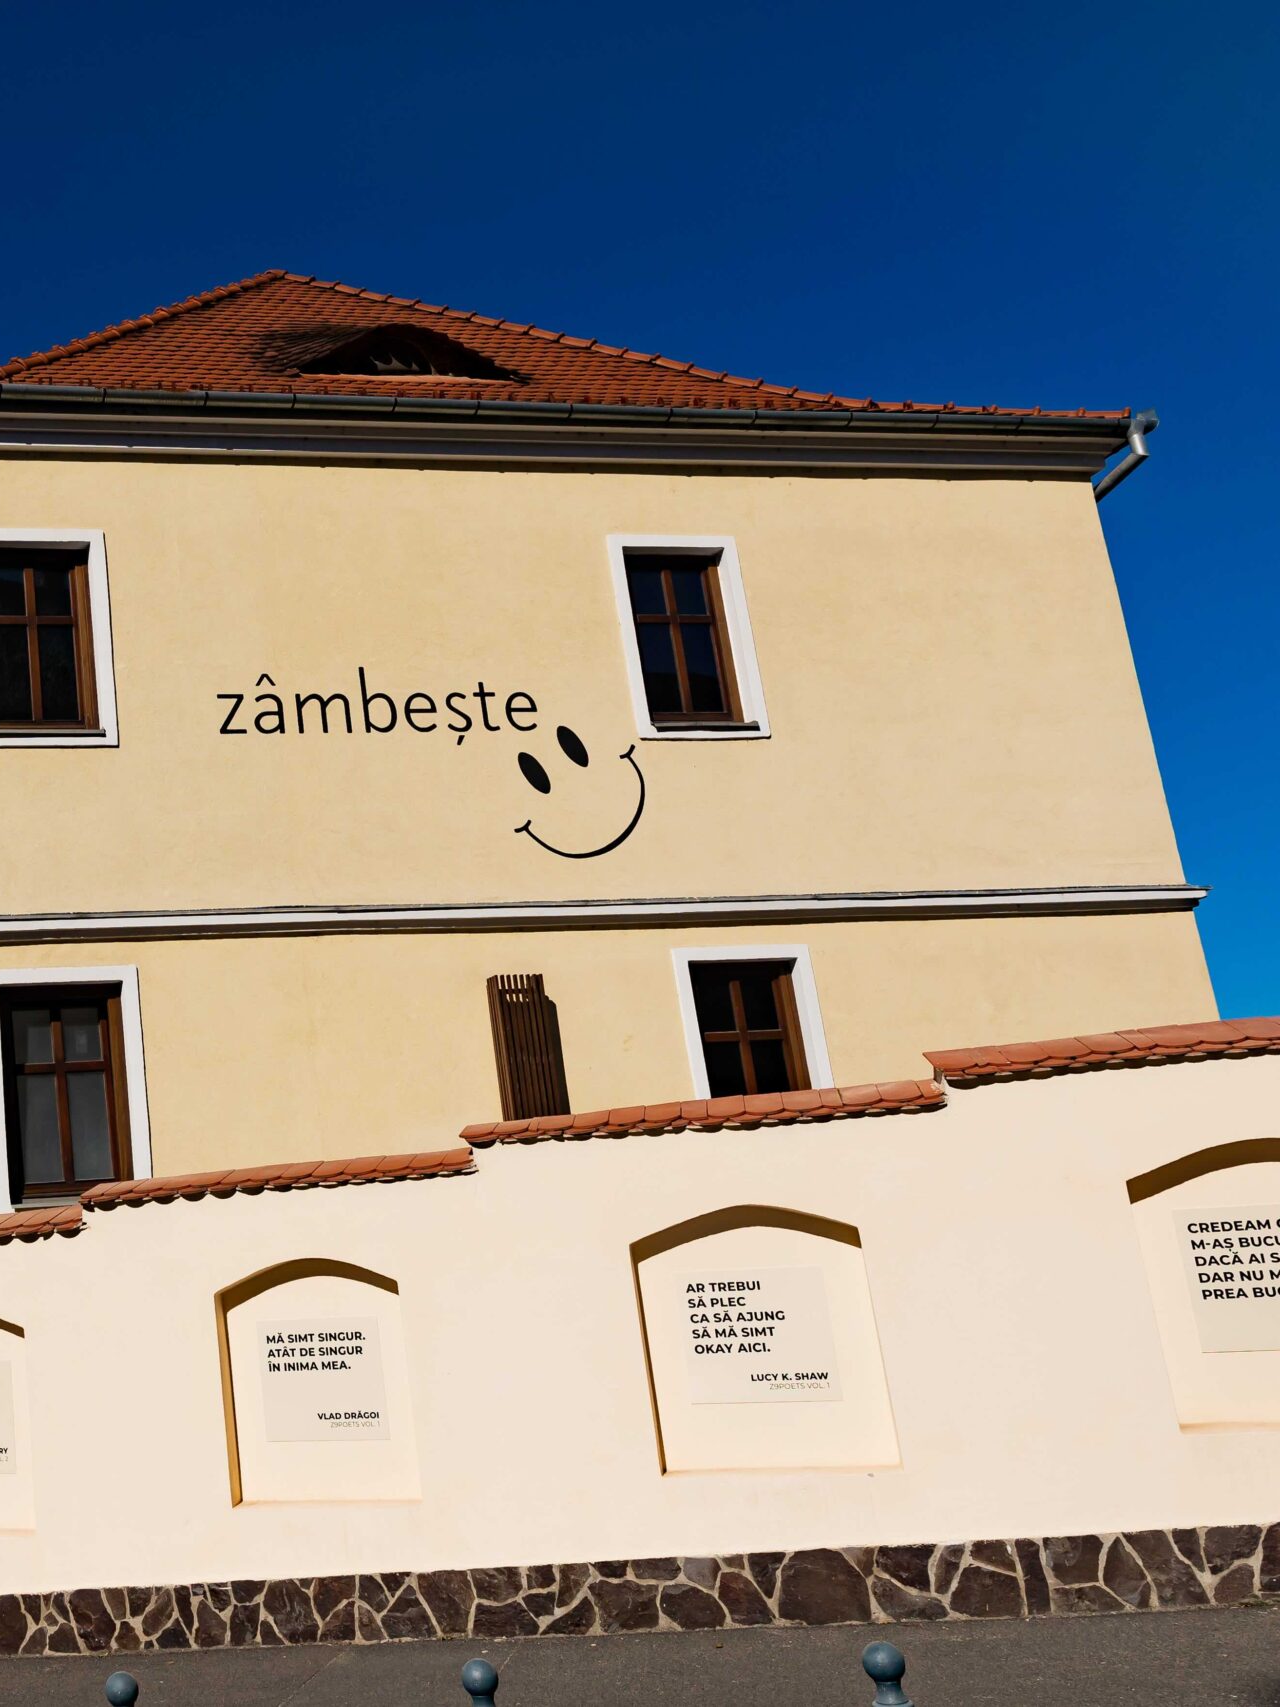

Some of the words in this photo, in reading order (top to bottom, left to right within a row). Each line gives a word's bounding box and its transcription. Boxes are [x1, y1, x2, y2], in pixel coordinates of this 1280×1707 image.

[217, 666, 538, 746] zâmbește
[1187, 1219, 1271, 1233] CREDEAM
[1191, 1238, 1234, 1252] M-AȘ
[1194, 1251, 1244, 1266] DACĂ
[1248, 1253, 1266, 1264] AI
[1198, 1271, 1235, 1283] DAR
[1239, 1269, 1264, 1282] NU
[686, 1283, 706, 1293] AR
[709, 1281, 761, 1292] TREBUI
[1202, 1288, 1249, 1300] PREA
[687, 1296, 707, 1309] SĂ
[710, 1297, 746, 1308] PLEC
[690, 1313, 710, 1324] CA
[713, 1310, 733, 1323] SĂ
[736, 1310, 786, 1322] AJUNG
[266, 1332, 285, 1344] MĂ
[287, 1333, 315, 1344] SIMT
[318, 1331, 366, 1342] SINGUR.
[692, 1327, 711, 1339] SĂ
[715, 1325, 738, 1338] MĂ
[741, 1326, 776, 1337] SIMT
[267, 1346, 296, 1358] ATÂT
[299, 1347, 315, 1357] DE
[318, 1346, 363, 1356] SINGUR
[694, 1343, 733, 1354] OKAY
[738, 1342, 771, 1353] AICI.
[268, 1361, 281, 1372] ÎN
[284, 1362, 319, 1372] INIMA
[321, 1360, 351, 1370] MEA.
[751, 1373, 778, 1382] LUCY
[781, 1373, 792, 1381] K.
[794, 1372, 829, 1380] SHAW
[317, 1412, 342, 1420] VLAD
[344, 1410, 380, 1419] DRĂGOI
